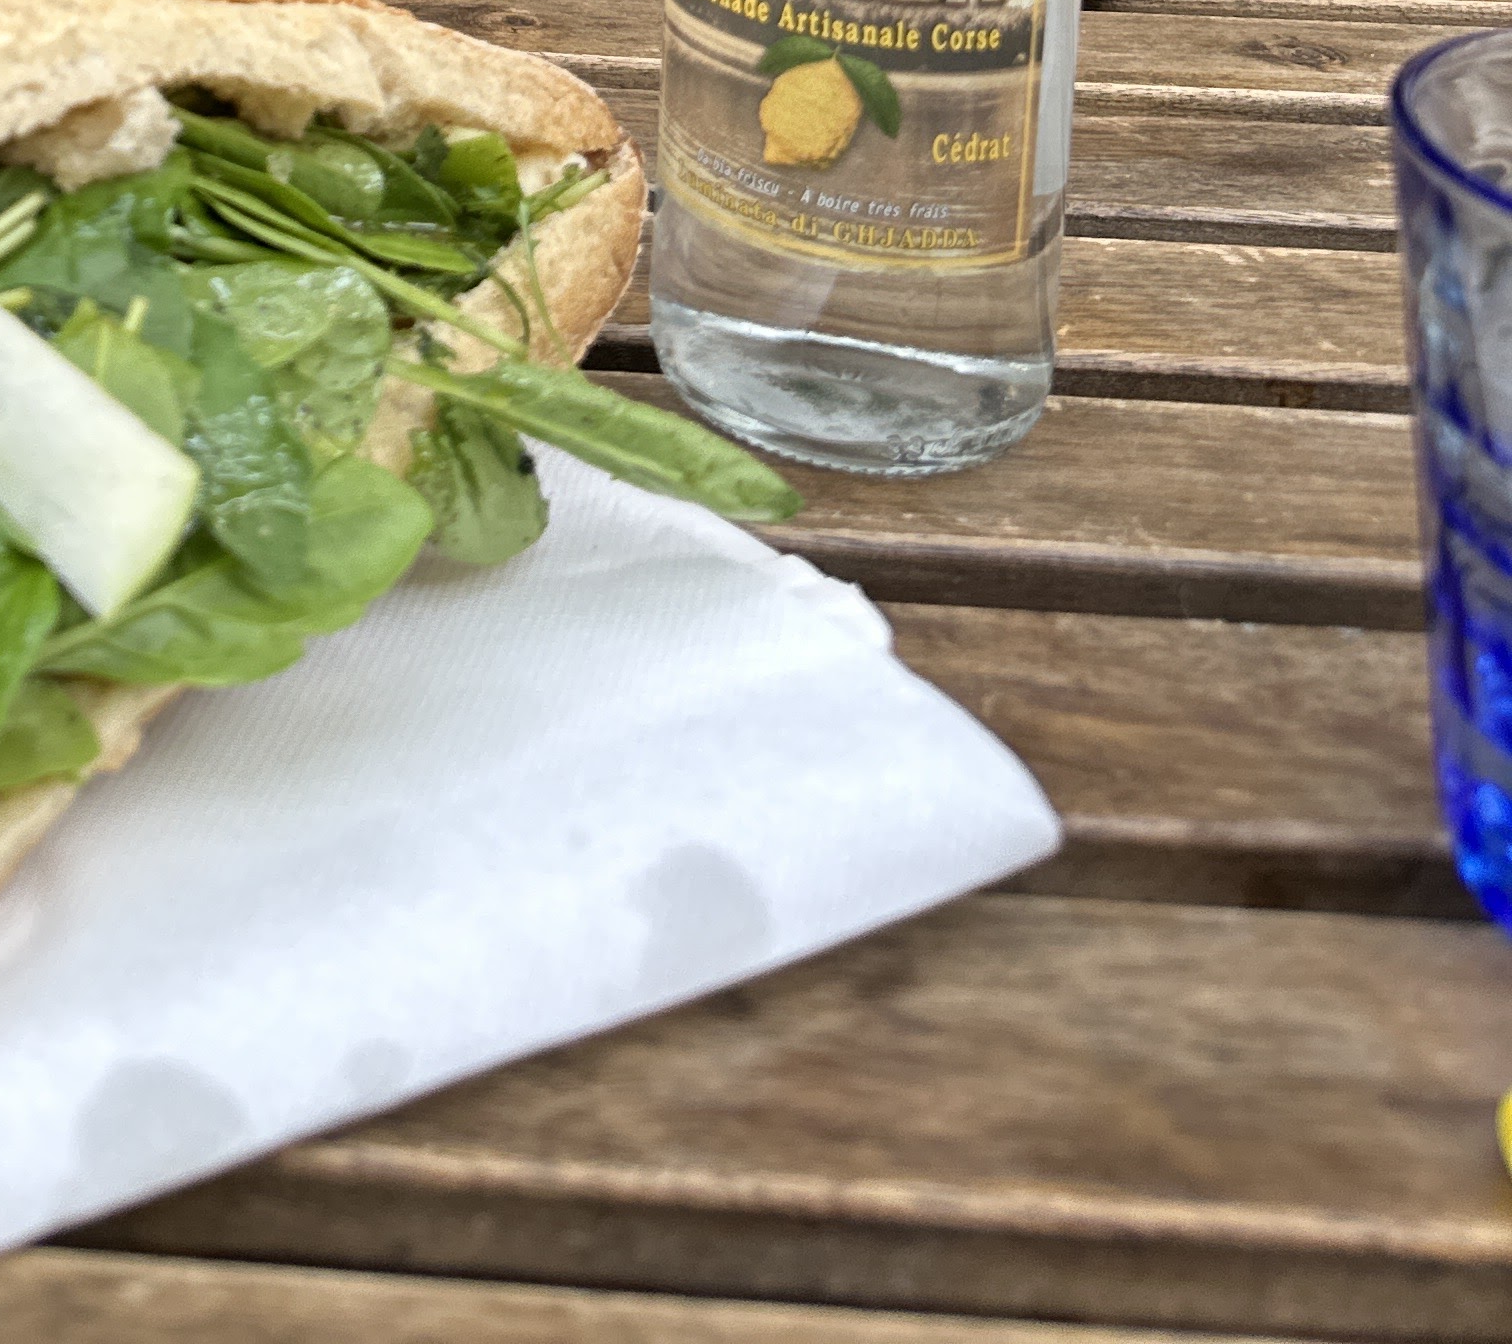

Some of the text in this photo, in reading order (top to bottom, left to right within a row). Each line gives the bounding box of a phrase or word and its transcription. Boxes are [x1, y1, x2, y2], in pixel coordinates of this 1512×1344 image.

[777, 3, 922, 51] Artisanale
[930, 24, 1002, 53] Corse
[932, 132, 1012, 165] Cédrat
[817, 189, 860, 214] boire
[909, 202, 950, 221] frais
